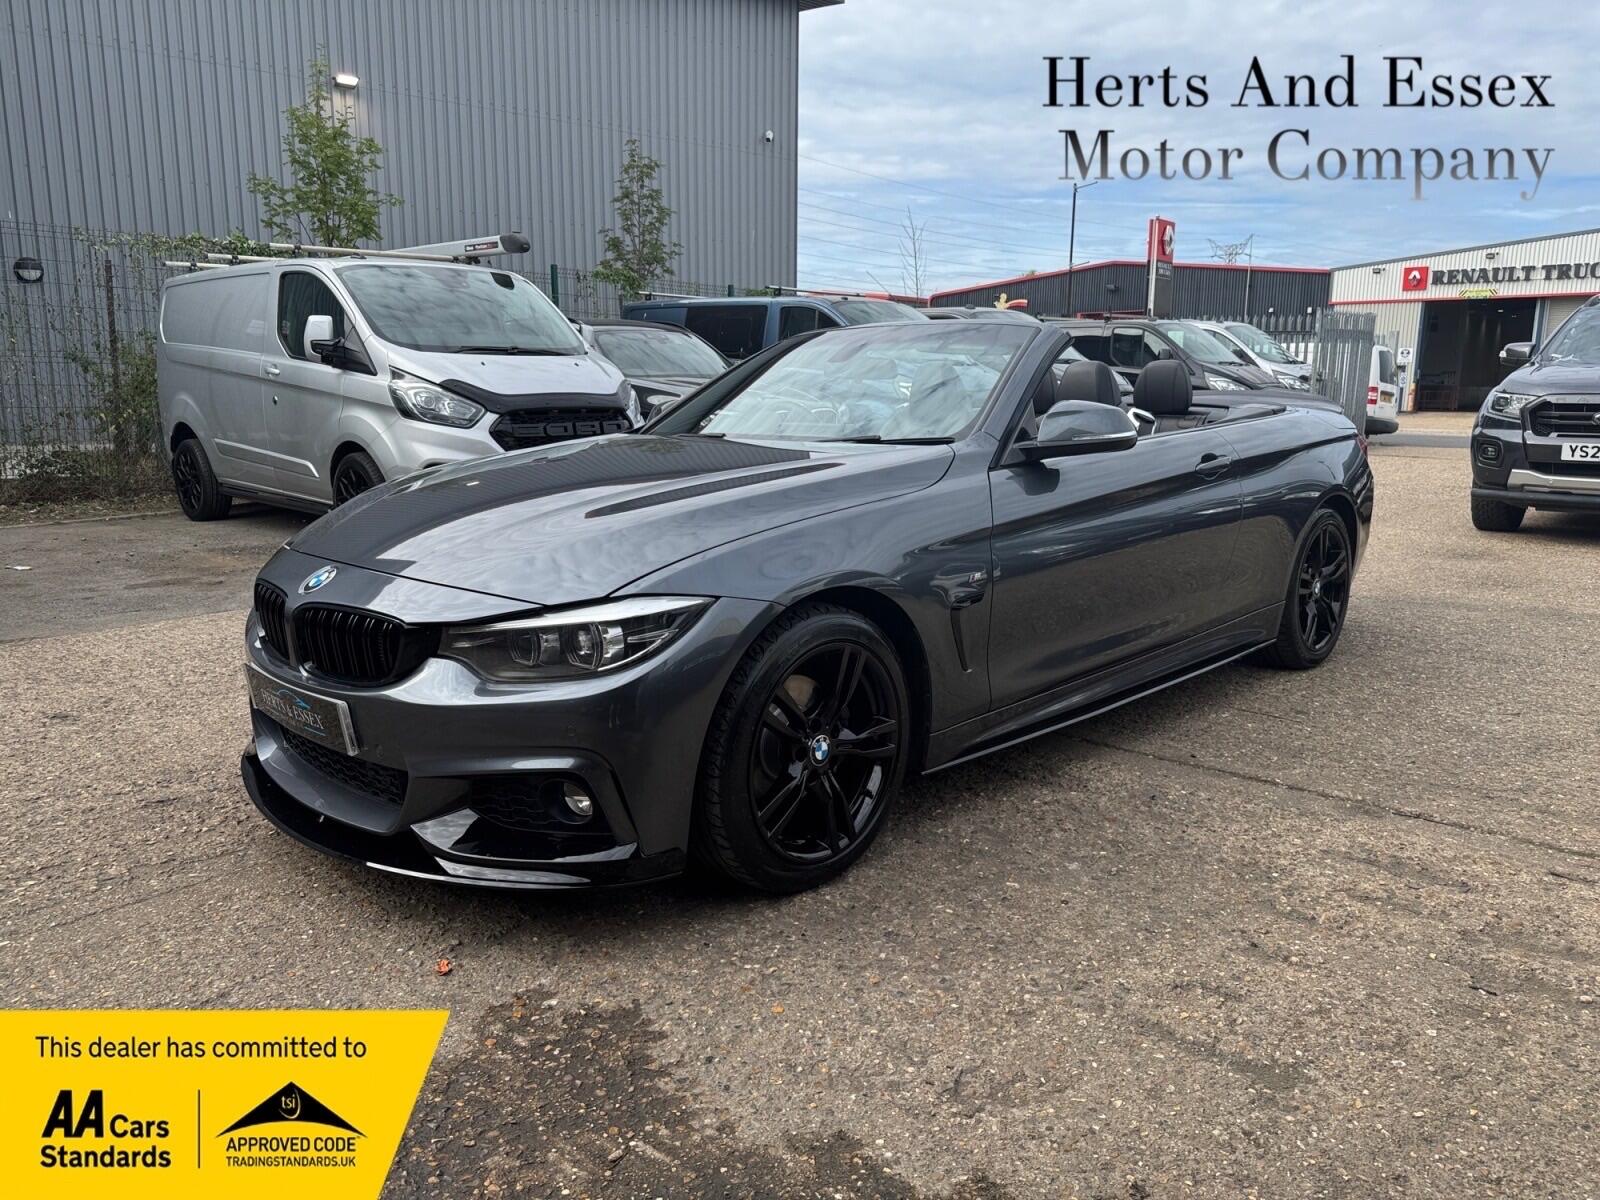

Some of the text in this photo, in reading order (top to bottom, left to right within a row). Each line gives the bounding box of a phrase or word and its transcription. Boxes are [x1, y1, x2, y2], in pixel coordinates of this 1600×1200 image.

[1431, 265, 1536, 286] RENAULT
[1569, 444, 1600, 459] YS2
[293, 704, 325, 730] ESSEX
